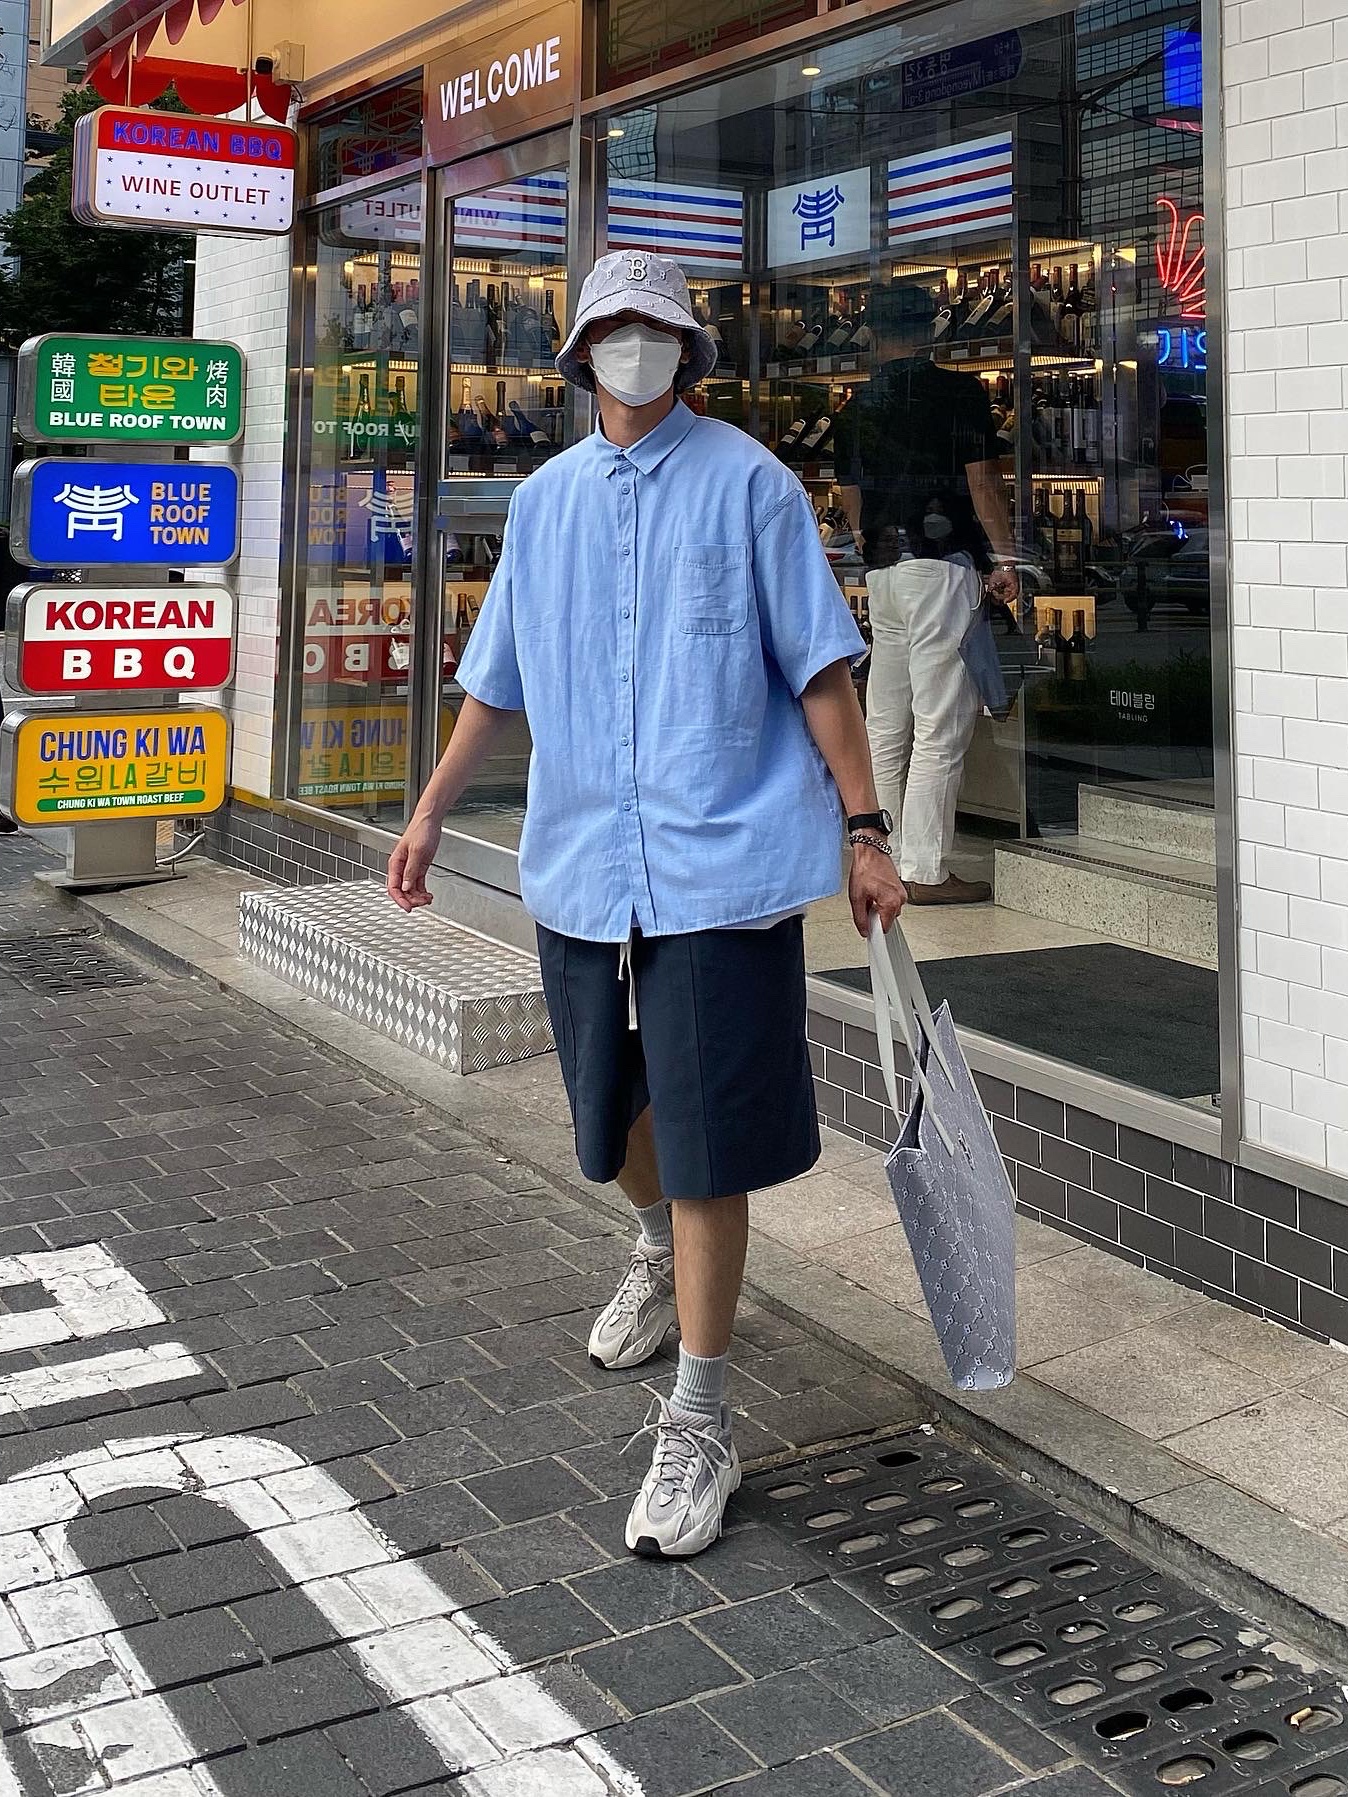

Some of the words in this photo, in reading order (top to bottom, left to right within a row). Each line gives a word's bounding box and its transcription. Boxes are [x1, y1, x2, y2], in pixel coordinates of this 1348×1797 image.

[440, 36, 560, 121] WELCOME
[113, 120, 219, 153] KOREAN
[230, 133, 282, 161] BBQ
[121, 175, 181, 197] WINE
[190, 182, 271, 206] OUTLET
[626, 257, 648, 281] B
[51, 353, 76, 403] 韓國
[205, 359, 229, 409] 烤肉
[99, 383, 176, 410] 타운
[50, 411, 103, 427] BLUE
[109, 413, 164, 429] ROOF
[169, 415, 226, 431] TOWN
[151, 482, 211, 502] BLUE
[150, 505, 210, 523] ROOF
[150, 526, 210, 545] TOWN
[46, 600, 214, 631] KOREAN
[1110, 690, 1155, 710] 테이블링
[1118, 711, 1148, 722] TABLING
[40, 729, 127, 762] CHUNG
[135, 727, 160, 758] KI
[167, 726, 206, 755] WA
[57, 800, 86, 810] CHUNG
[87, 799, 96, 808] KI
[97, 798, 111, 807] WA
[112, 796, 136, 806] TOWN
[137, 793, 163, 804] ROAST
[164, 792, 185, 803] BEEF
